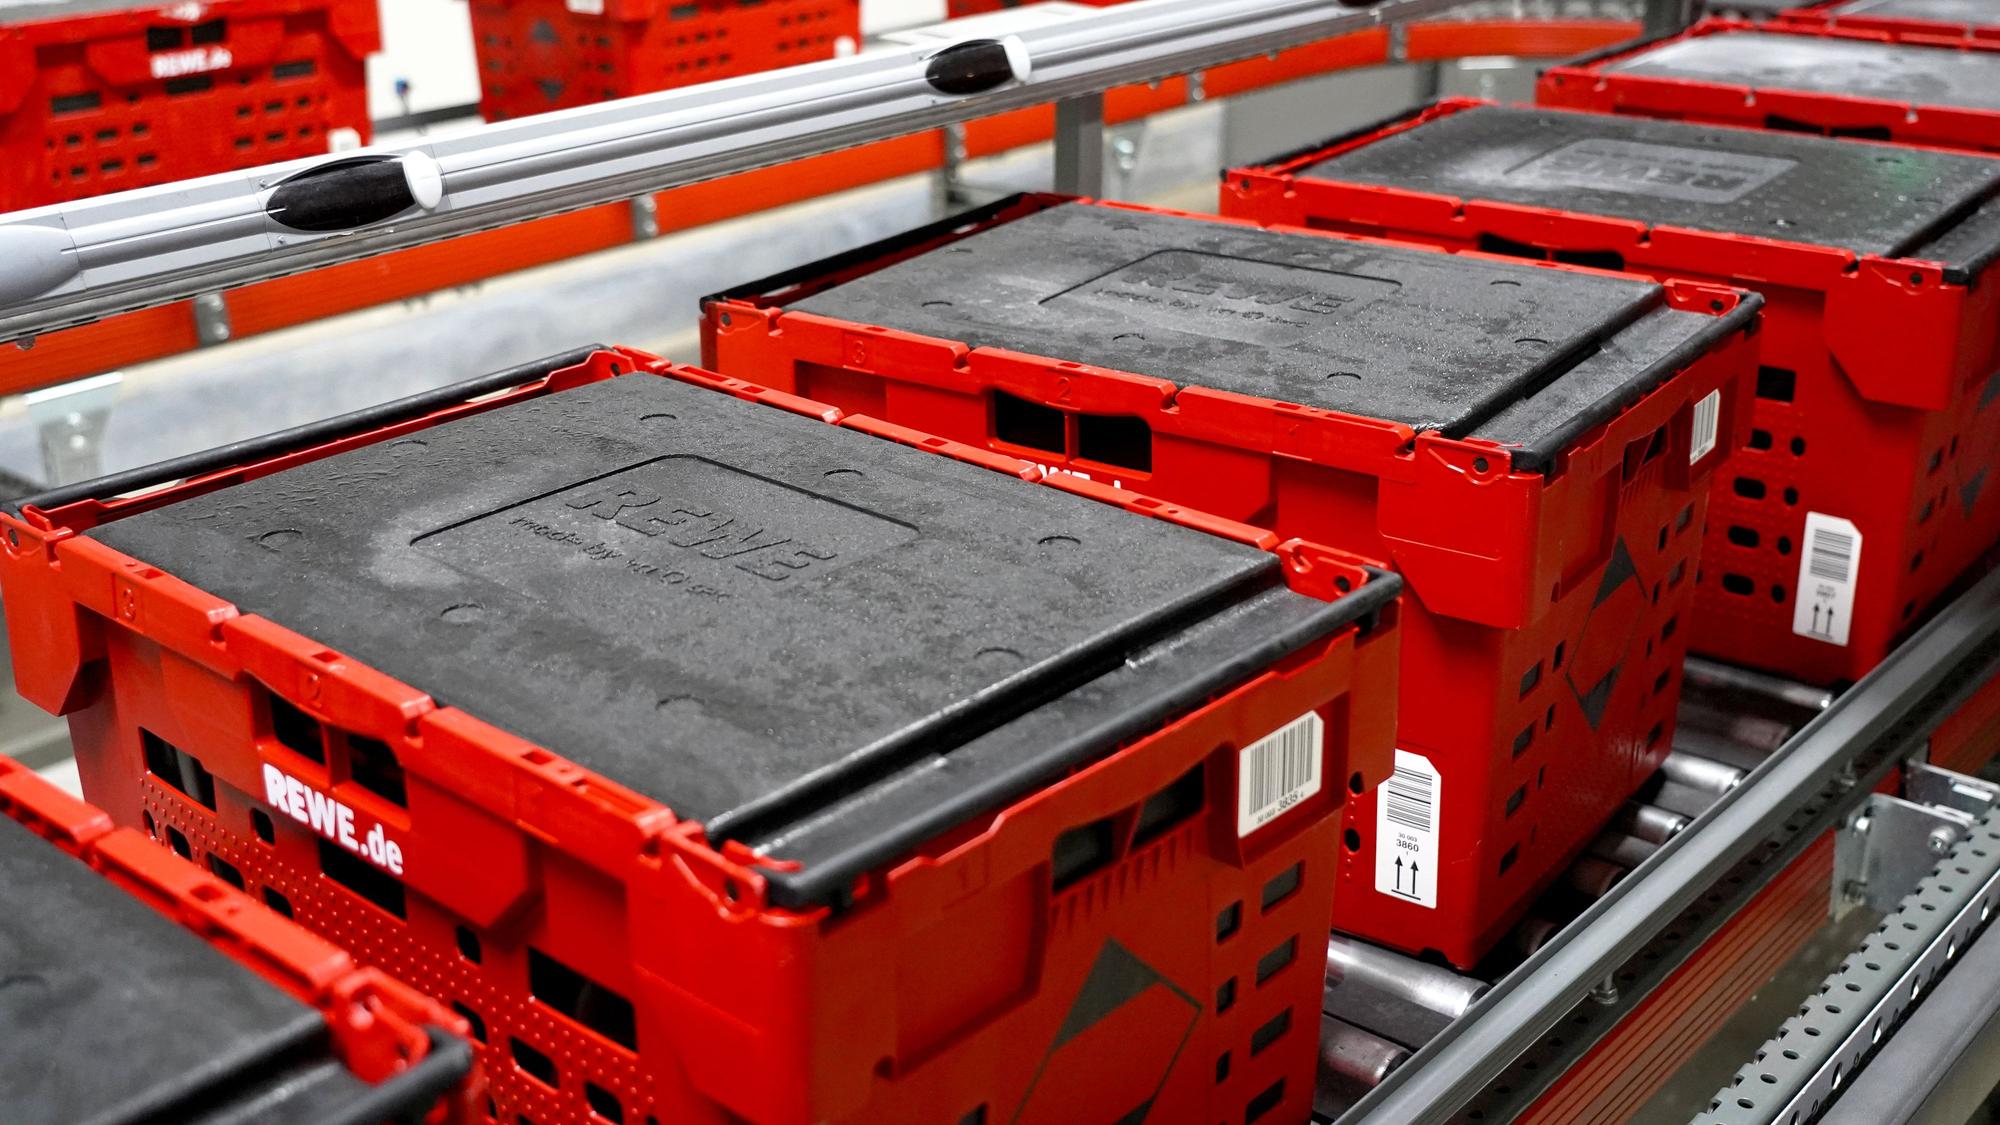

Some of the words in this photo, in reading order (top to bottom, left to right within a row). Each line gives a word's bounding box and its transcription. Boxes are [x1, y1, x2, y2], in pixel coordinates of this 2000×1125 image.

[563, 486, 839, 582] REWE
[263, 763, 404, 876] REWE.de
[1396, 838, 1419, 852] 3860
